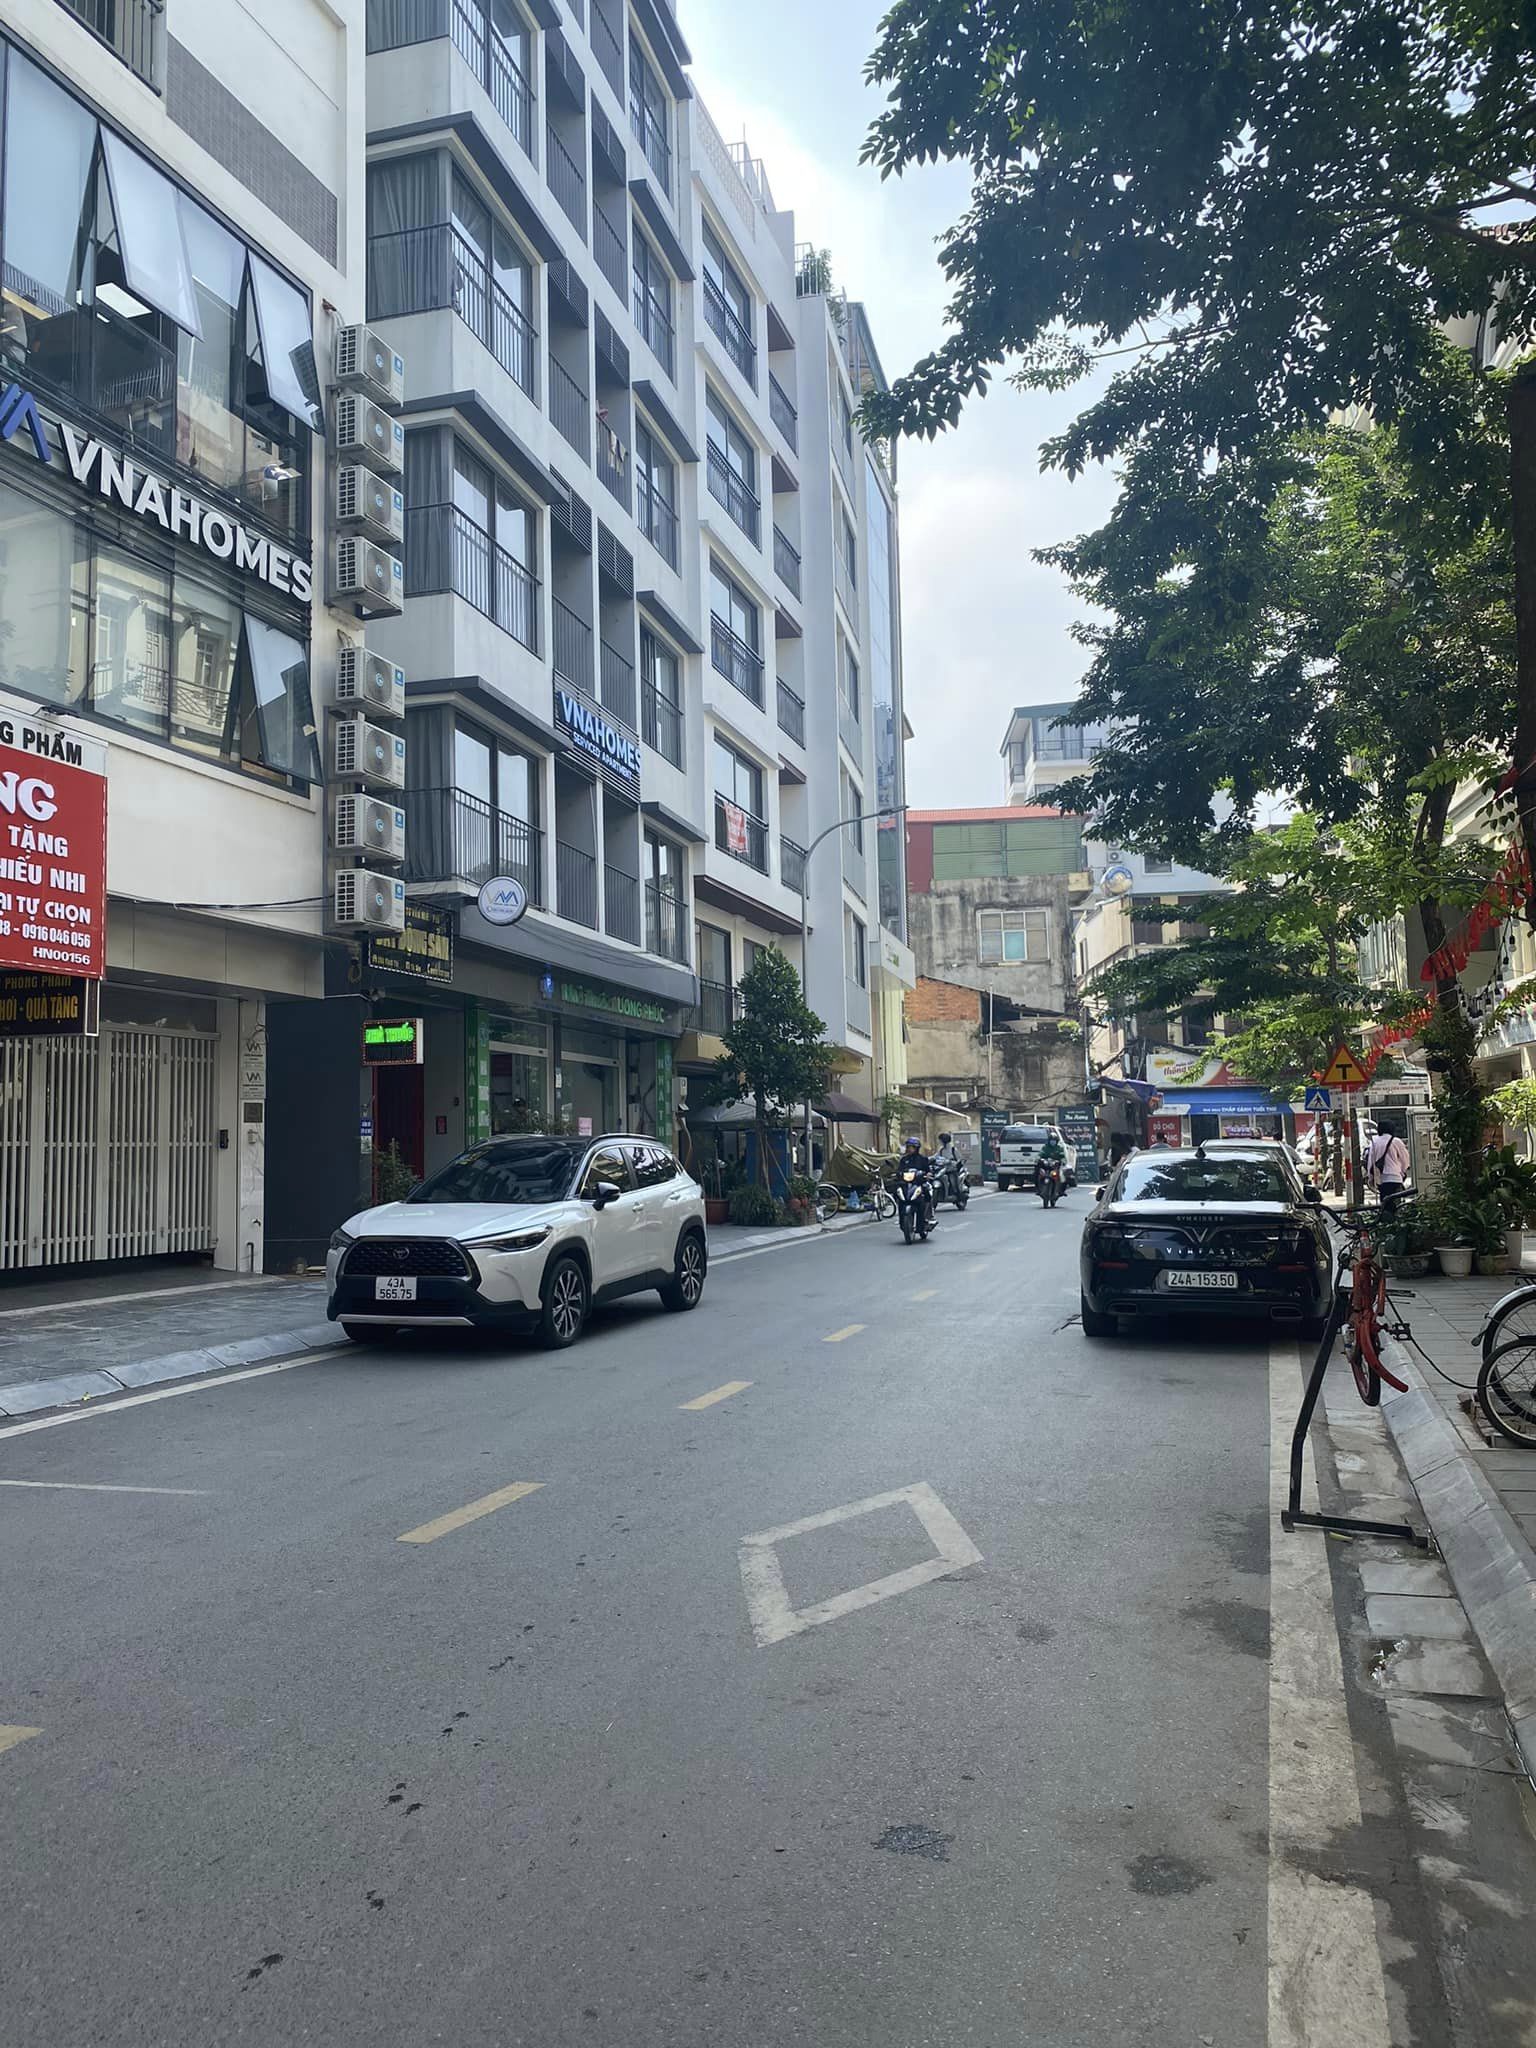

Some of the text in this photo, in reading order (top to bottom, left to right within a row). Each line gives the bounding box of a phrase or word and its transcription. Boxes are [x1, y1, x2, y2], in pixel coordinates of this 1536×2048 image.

[57, 422, 312, 602] VNAHOMES
[23, 730, 83, 766] PHẨM
[561, 691, 641, 774] VNAHOMES
[8, 823, 69, 858] TẶNG
[50, 867, 87, 894] NHI
[16, 896, 40, 921] TỰ
[45, 901, 91, 928] CHỌN
[33, 946, 91, 965] HN00156
[26, 993, 48, 1022] QUÀ
[50, 993, 78, 1024] TẶNG
[379, 1288, 412, 1300] 565.75
[387, 1277, 405, 1288] 43A
[1170, 1272, 1235, 1287] 24A-153.50
